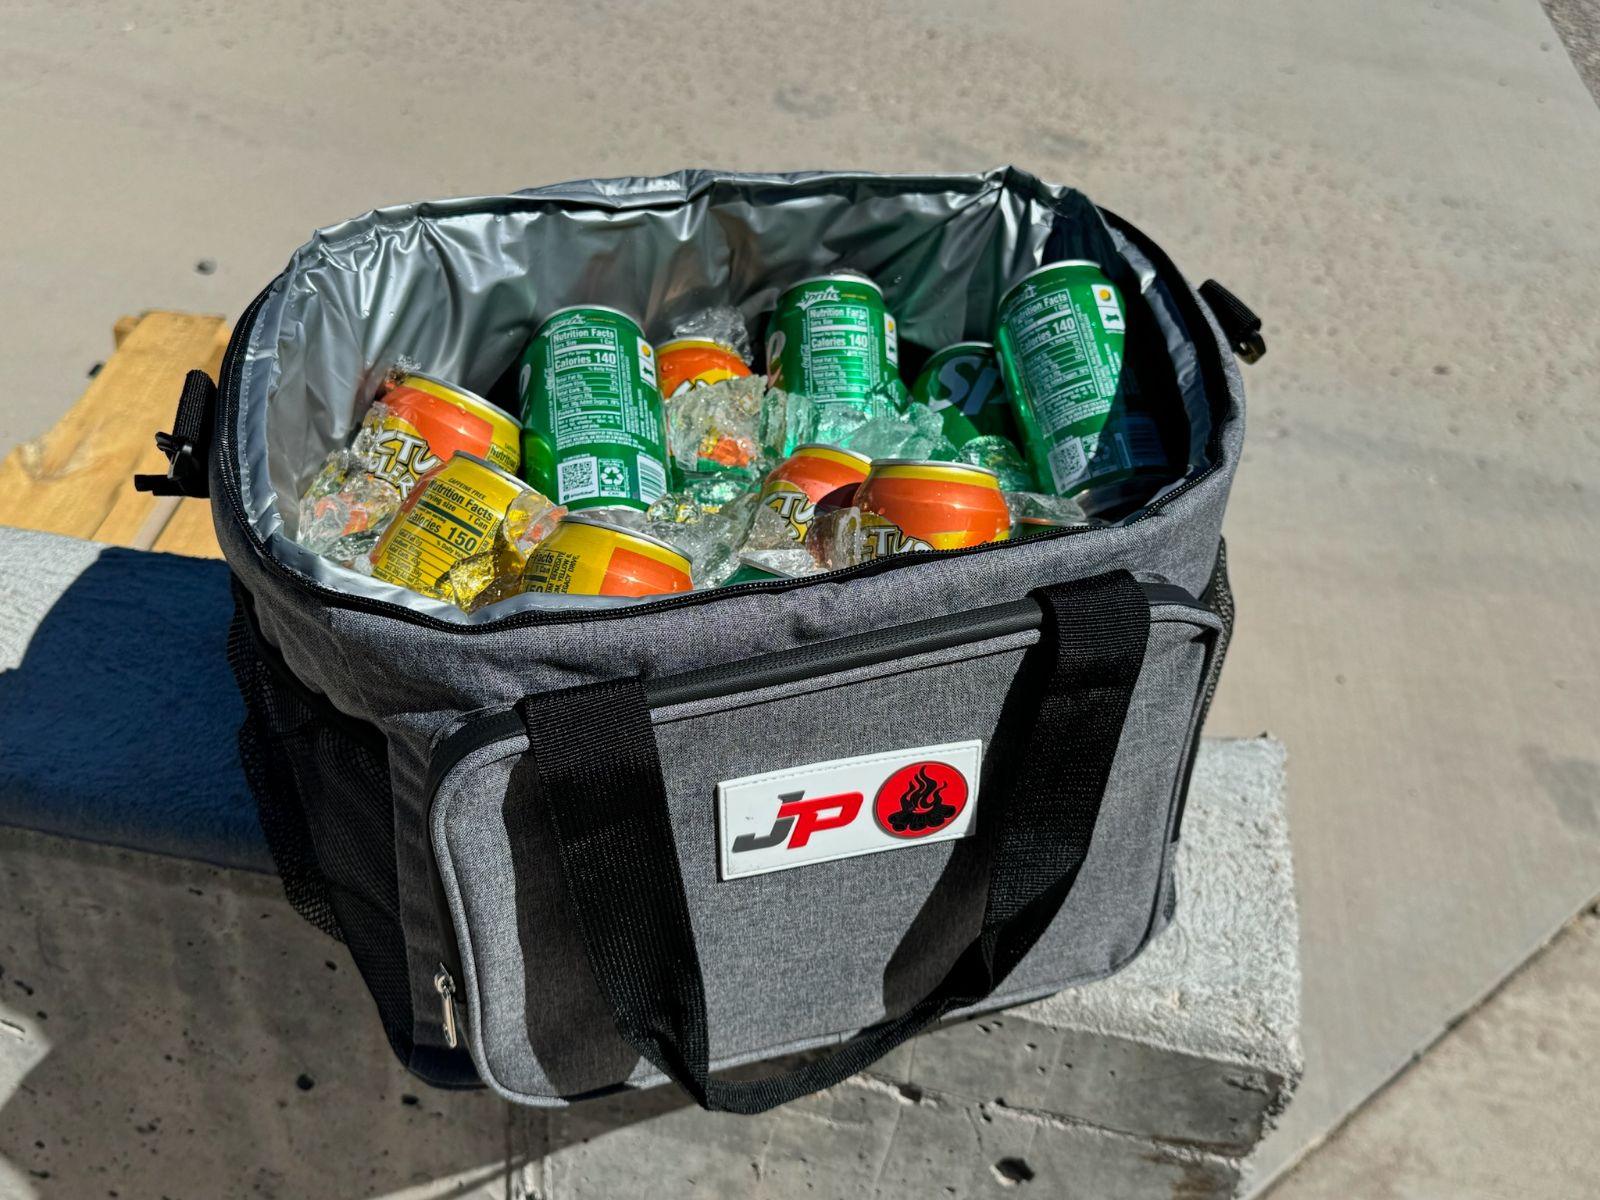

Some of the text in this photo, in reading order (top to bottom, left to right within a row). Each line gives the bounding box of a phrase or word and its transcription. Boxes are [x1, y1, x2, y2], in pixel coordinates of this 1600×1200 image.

[1044, 293, 1068, 307] Facts
[810, 308, 845, 318] Nutrition
[1052, 317, 1076, 334] 140
[553, 328, 615, 342] Nutrition Facts
[811, 337, 846, 349] Calories
[849, 334, 868, 348] 140
[555, 355, 591, 370] Calories
[594, 352, 617, 365] 140
[428, 479, 495, 521] Nutrition Facts
[441, 501, 456, 512] size
[407, 509, 442, 533] Calories
[447, 525, 478, 552] 150
[473, 517, 488, 530] Can
[731, 790, 864, 853] JP
